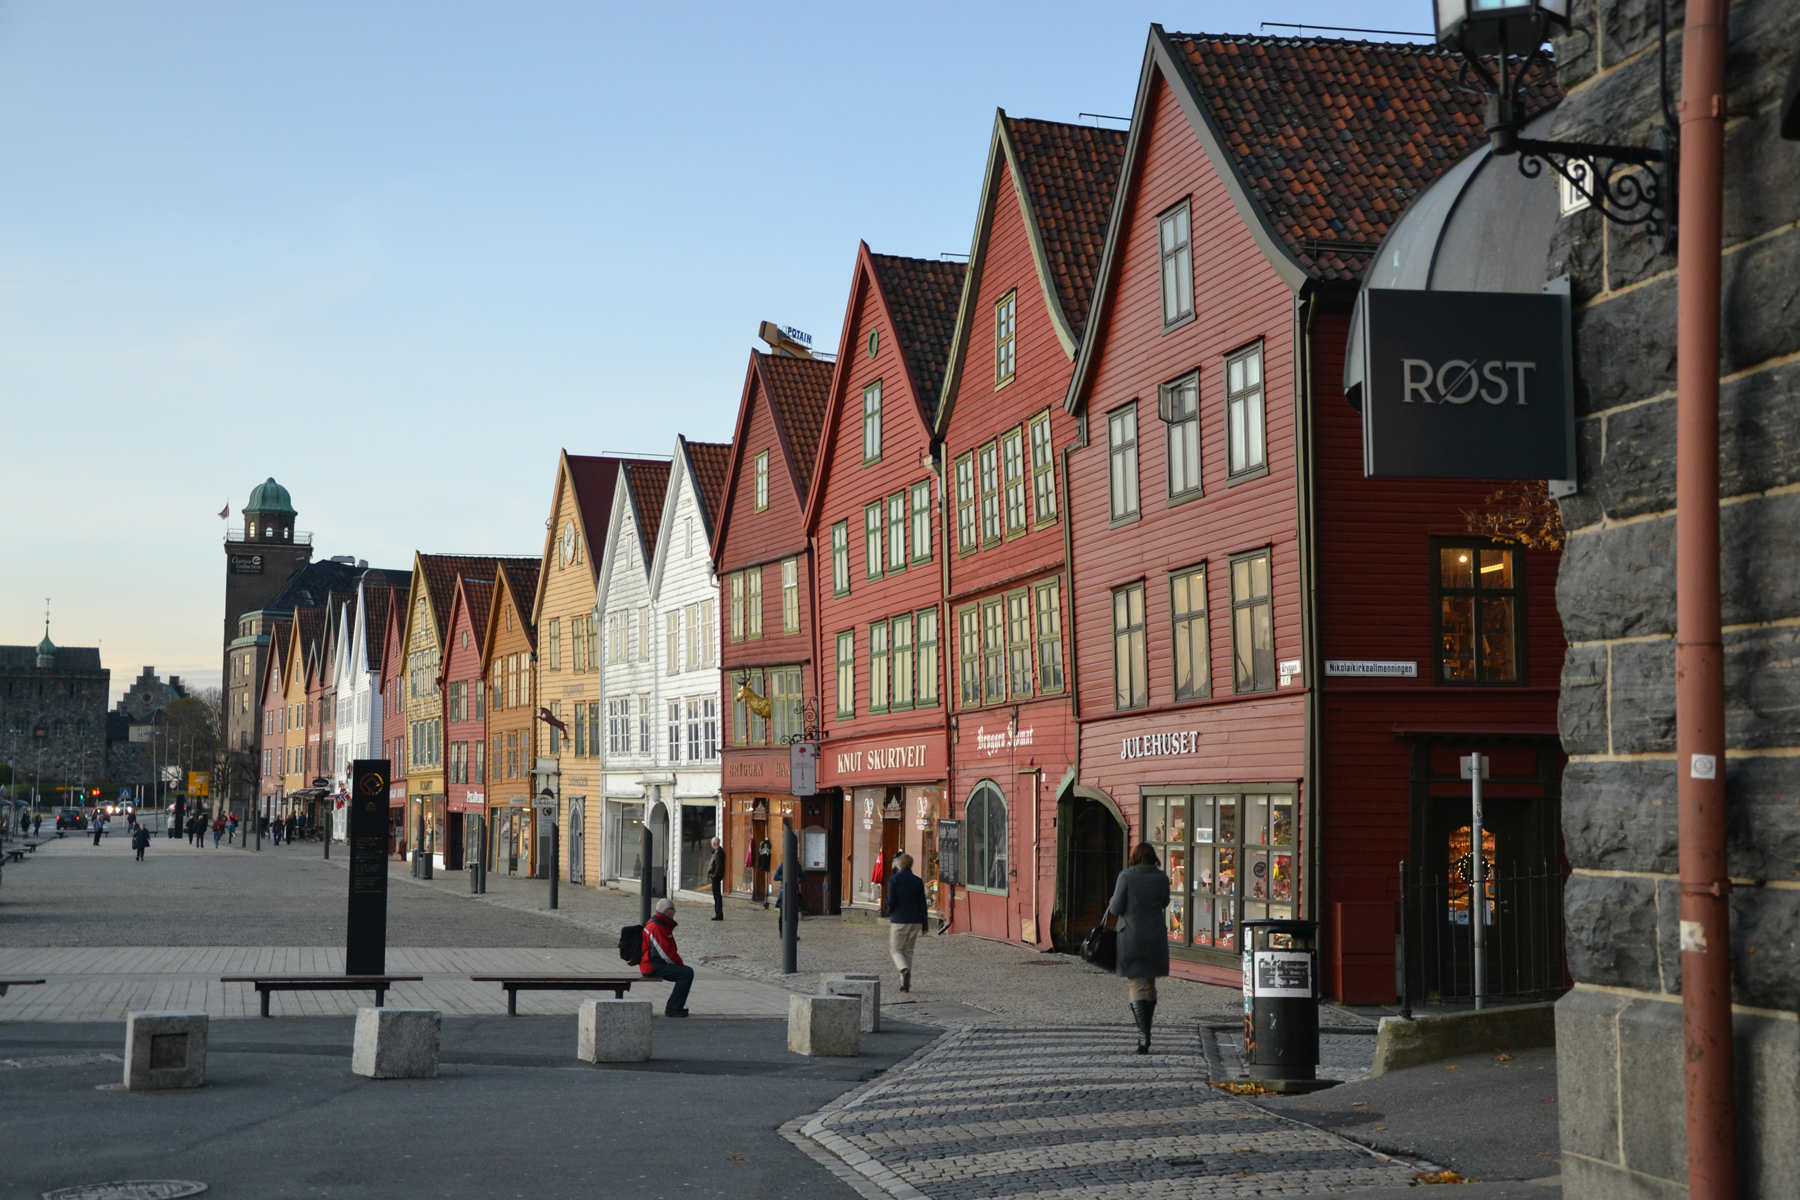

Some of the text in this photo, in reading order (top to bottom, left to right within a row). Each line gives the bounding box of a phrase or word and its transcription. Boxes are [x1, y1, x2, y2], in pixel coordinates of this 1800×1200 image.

[788, 326, 812, 344] POTAIN
[1401, 359, 1536, 405] RØST
[1329, 663, 1413, 675] Nikolaikirkeallmenningen
[838, 744, 927, 774] KNUT SKURTVEIT
[1121, 730, 1199, 760] JULEHUSET
